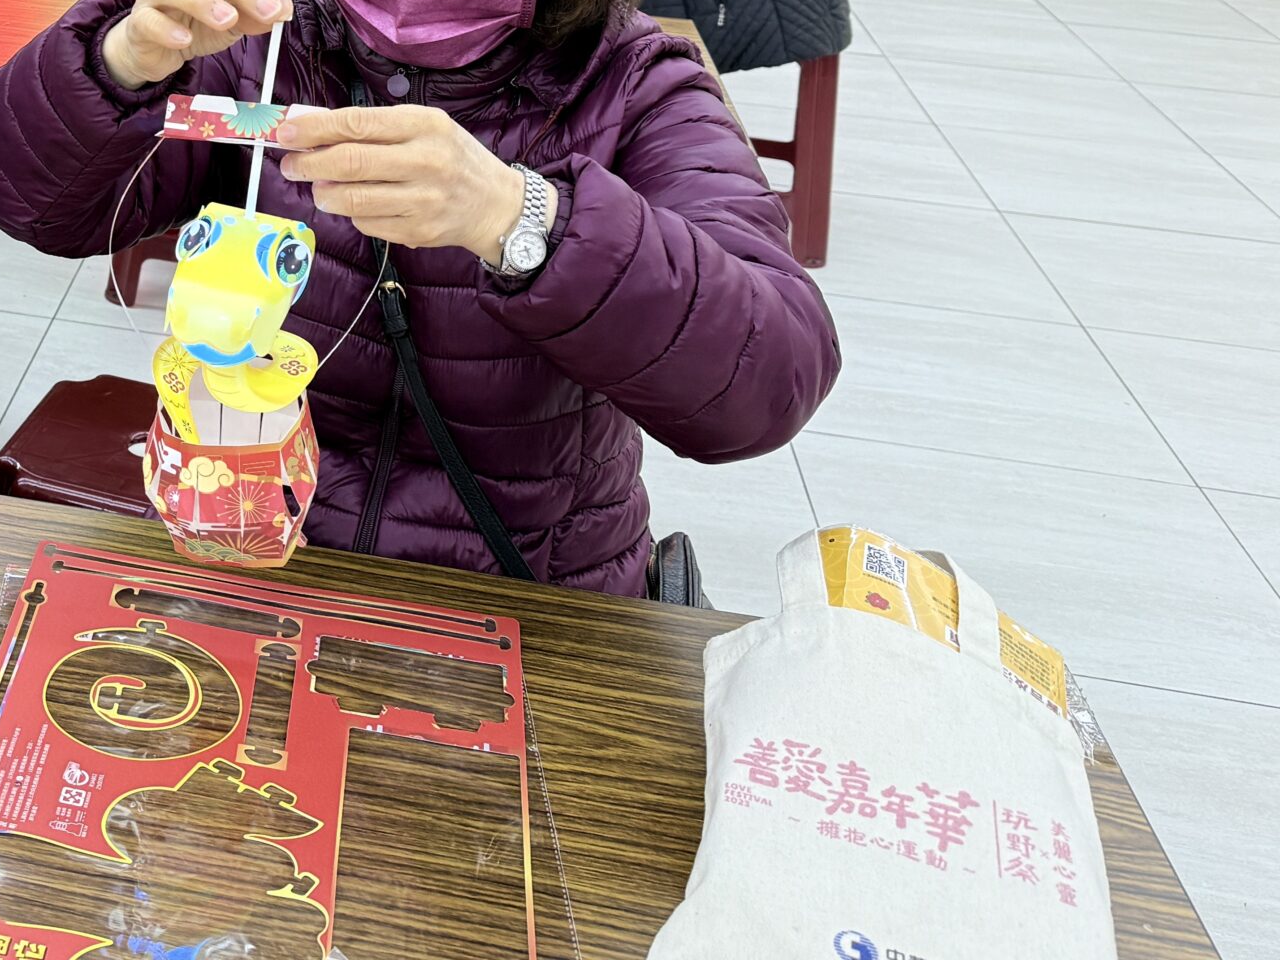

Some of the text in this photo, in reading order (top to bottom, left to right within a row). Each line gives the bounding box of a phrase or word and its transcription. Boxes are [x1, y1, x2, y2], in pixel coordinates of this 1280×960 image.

[724, 782, 752, 794] LOVE
[724, 789, 773, 807] FESTIVAL
[733, 737, 981, 853] 善愛嘉年華
[816, 819, 949, 872] 擁抱心運動
